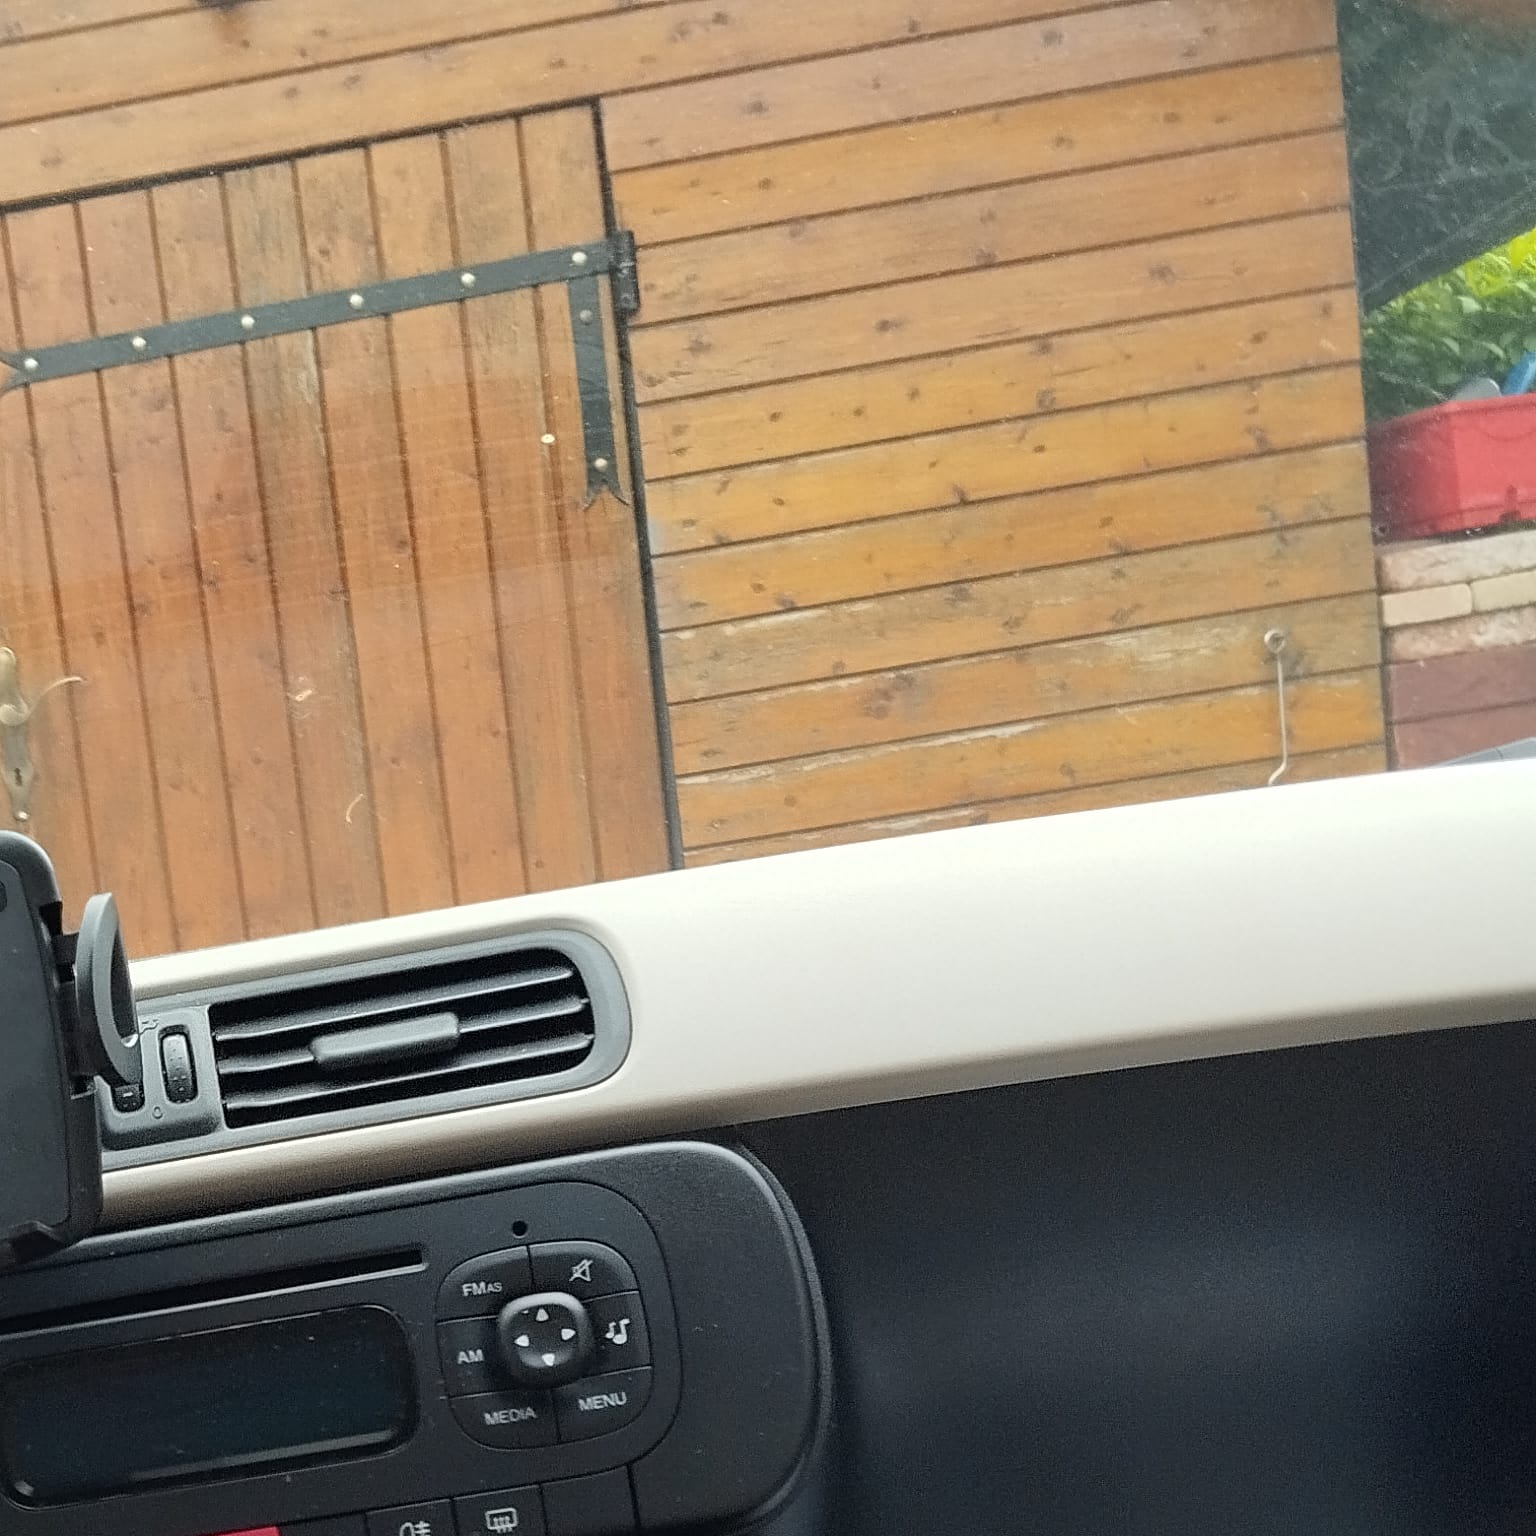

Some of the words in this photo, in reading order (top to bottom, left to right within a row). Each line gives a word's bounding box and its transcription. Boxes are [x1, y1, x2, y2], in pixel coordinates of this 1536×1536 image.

[456, 1349, 485, 1365] AM
[577, 1391, 628, 1412] MENU
[483, 1406, 537, 1426] MEDIA
